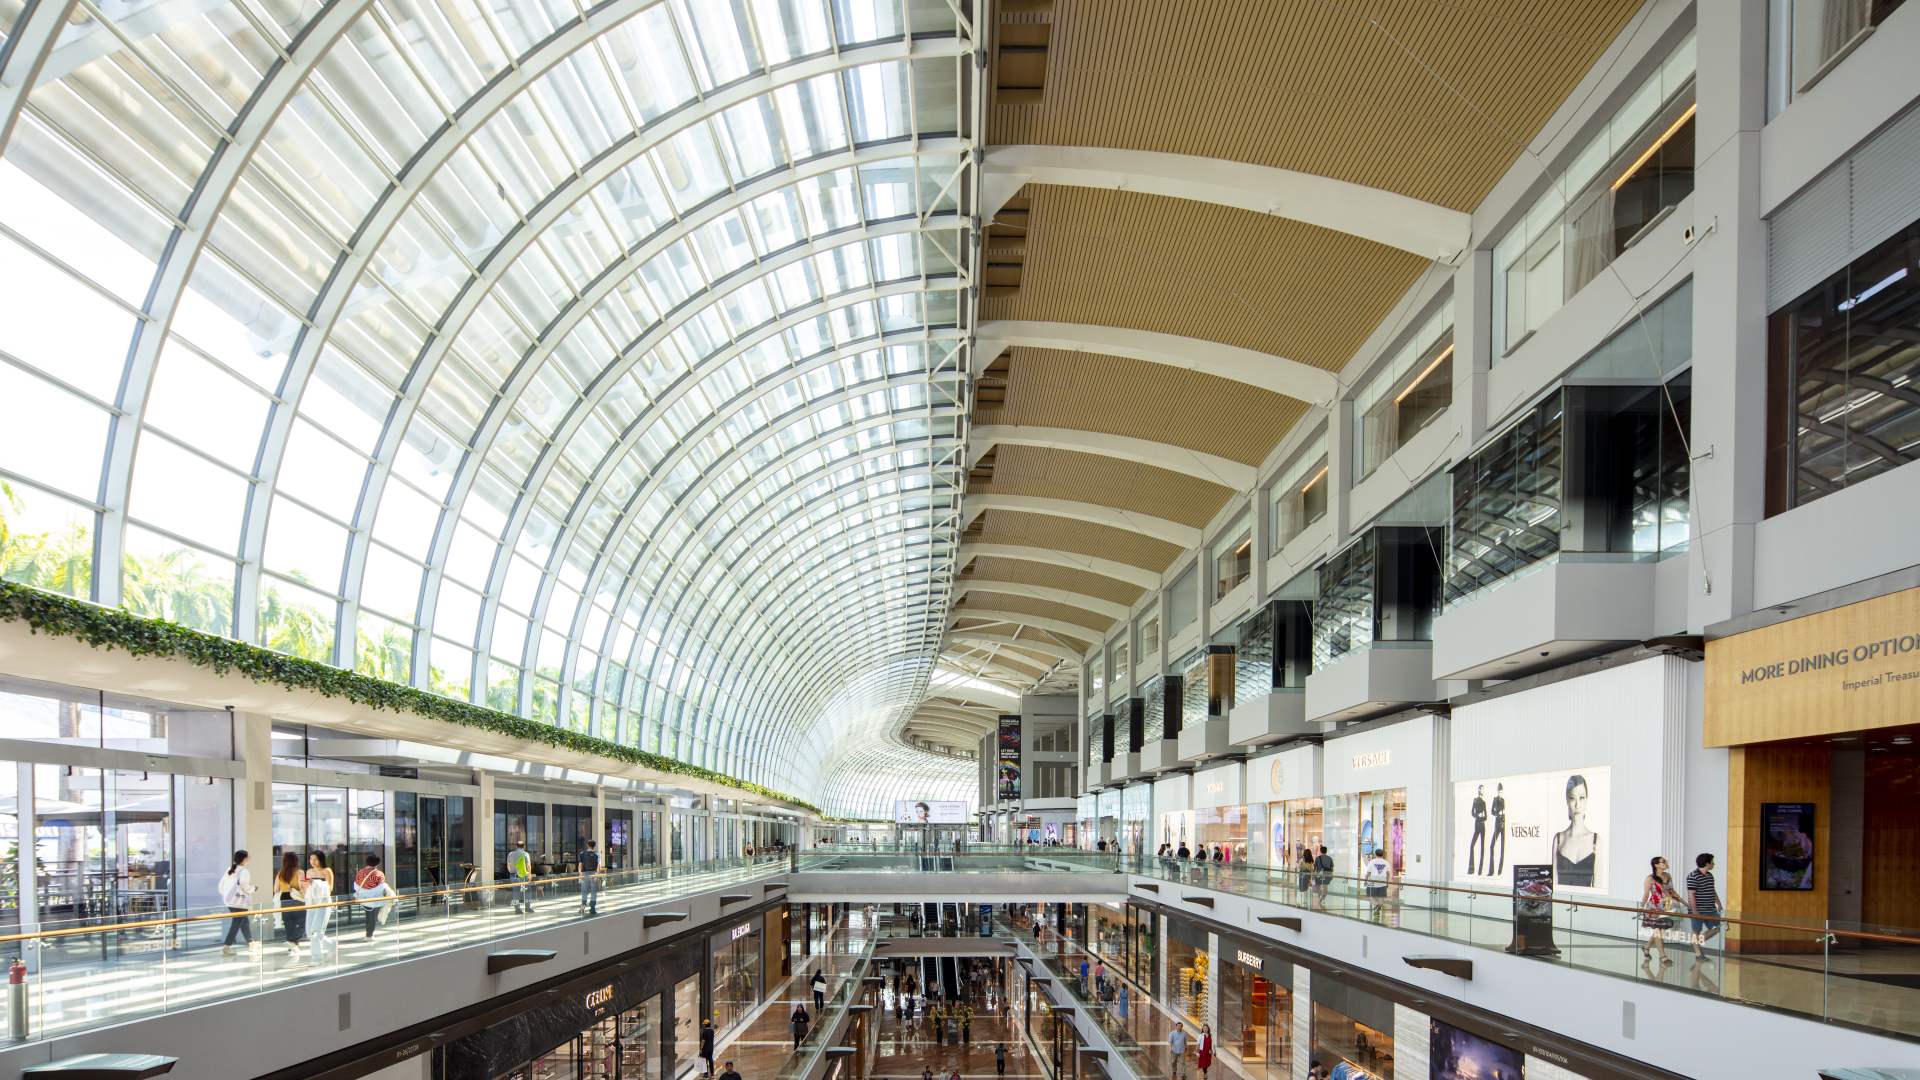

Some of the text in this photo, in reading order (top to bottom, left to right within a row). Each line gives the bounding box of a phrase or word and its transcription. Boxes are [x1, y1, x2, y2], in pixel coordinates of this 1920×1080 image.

[1741, 664, 1784, 685] MORE
[1788, 650, 1849, 675] DINING
[1842, 674, 1882, 690] Imperial
[1511, 826, 1541, 838] VERSACE
[1238, 950, 1262, 970] BURBERRY
